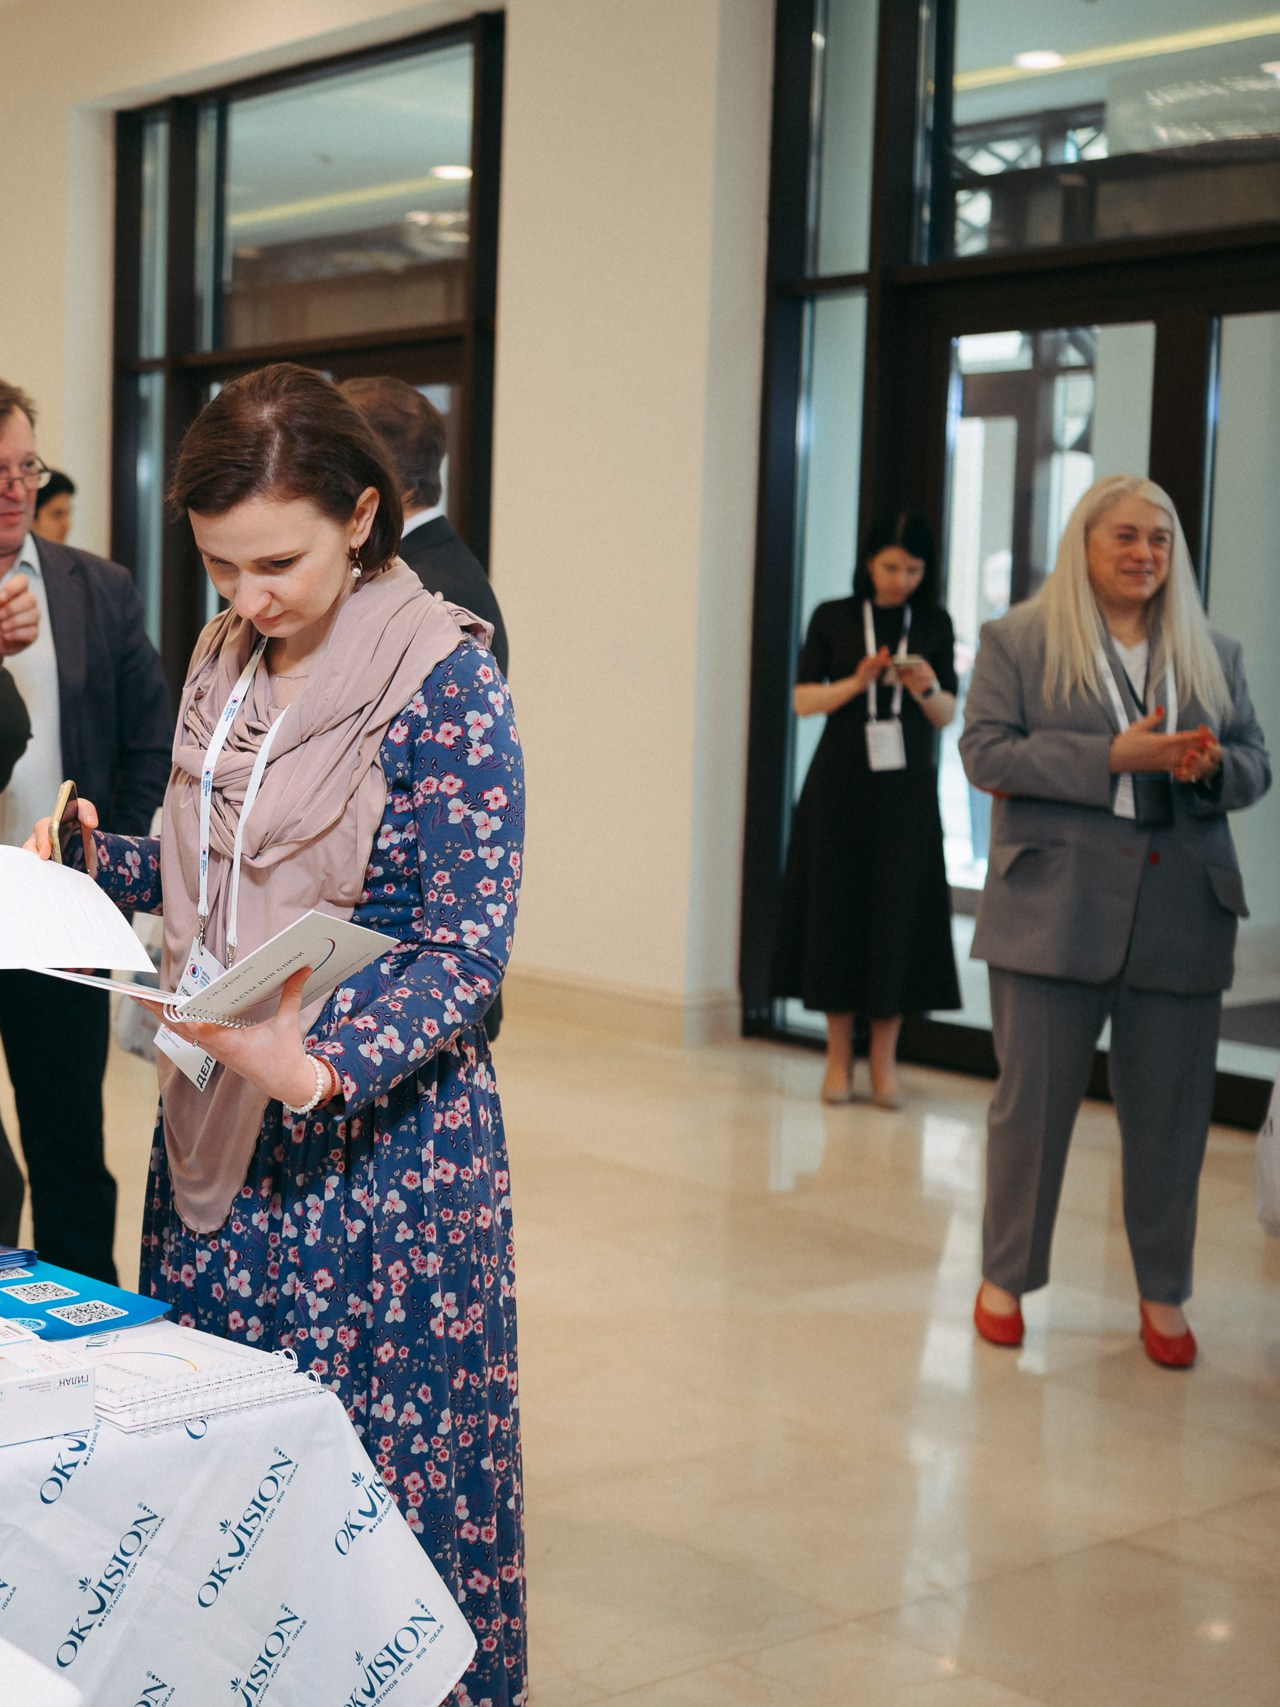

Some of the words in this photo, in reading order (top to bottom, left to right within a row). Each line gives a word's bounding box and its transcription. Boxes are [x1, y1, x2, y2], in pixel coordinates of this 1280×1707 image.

[59, 1374, 89, 1387] ГИЛАН
[400, 1662, 414, 1677] FOR
[428, 1623, 445, 1645] IDEAS
